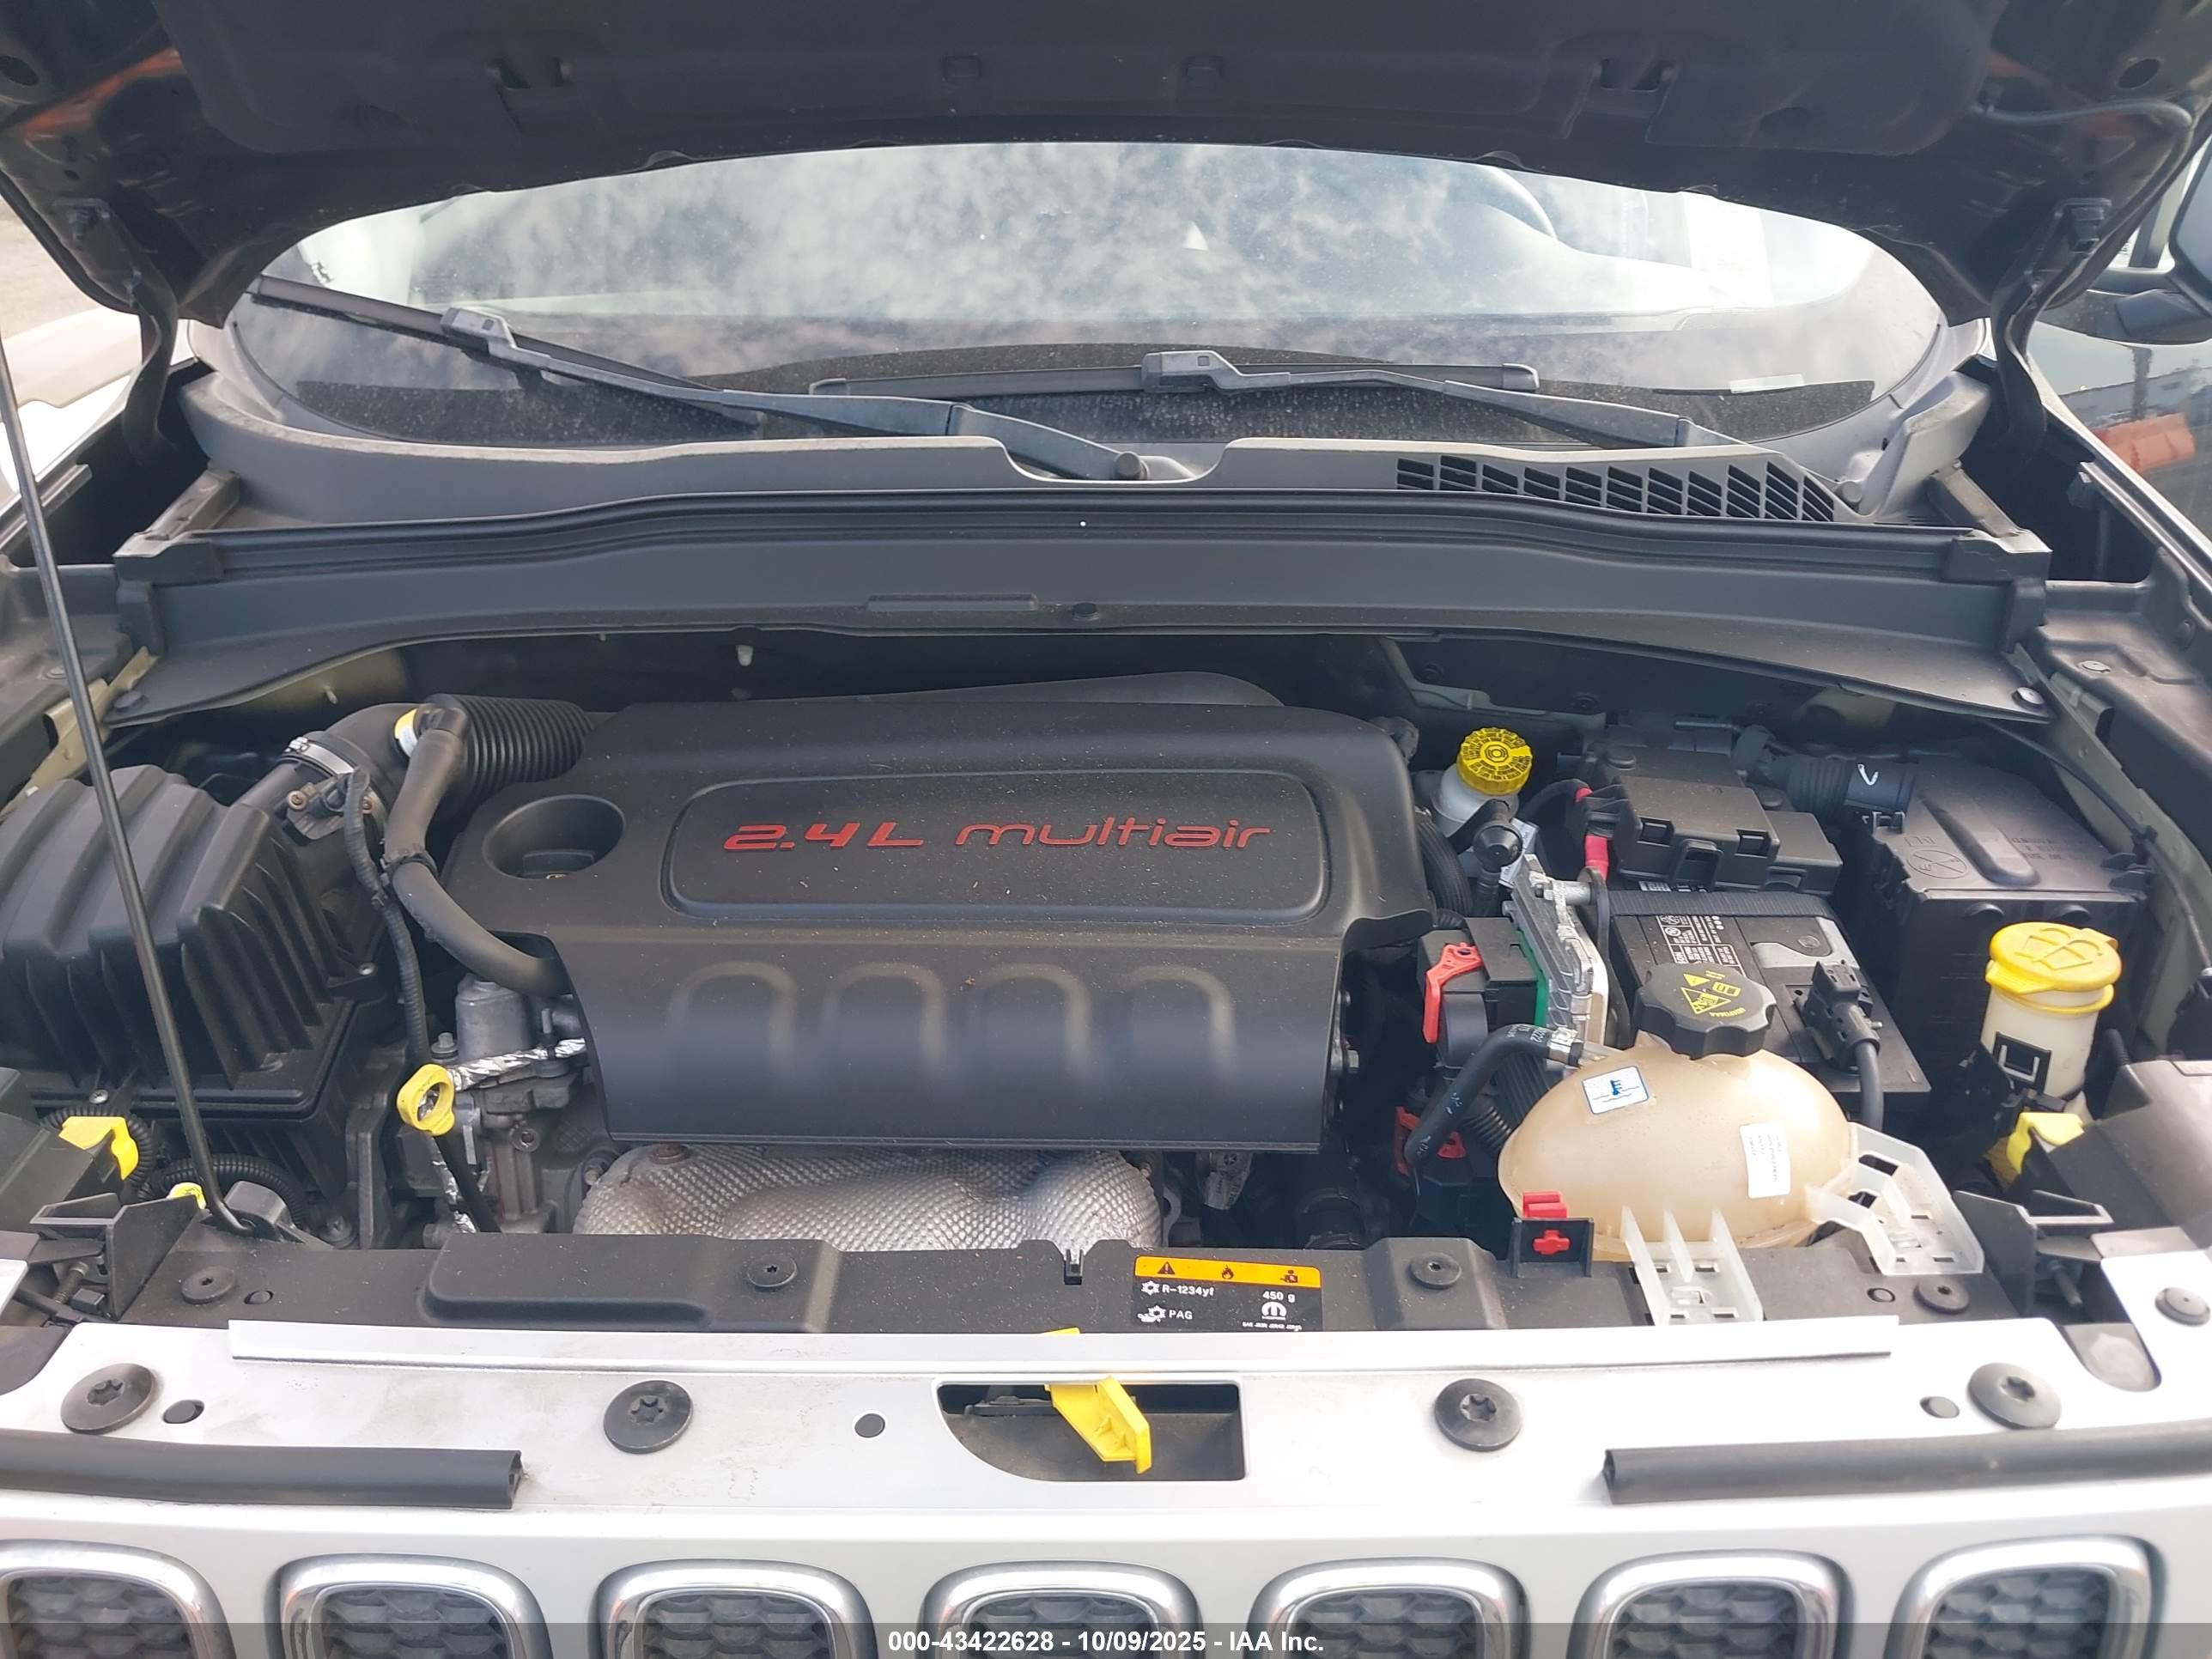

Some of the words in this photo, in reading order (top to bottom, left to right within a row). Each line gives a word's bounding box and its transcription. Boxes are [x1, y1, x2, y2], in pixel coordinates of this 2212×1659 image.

[956, 817, 1270, 849] multiair
[1162, 1284, 1215, 1297] R-1234yf
[1262, 1291, 1285, 1300] 450
[1287, 1293, 1296, 1304] g
[1169, 1309, 1193, 1320] PAG
